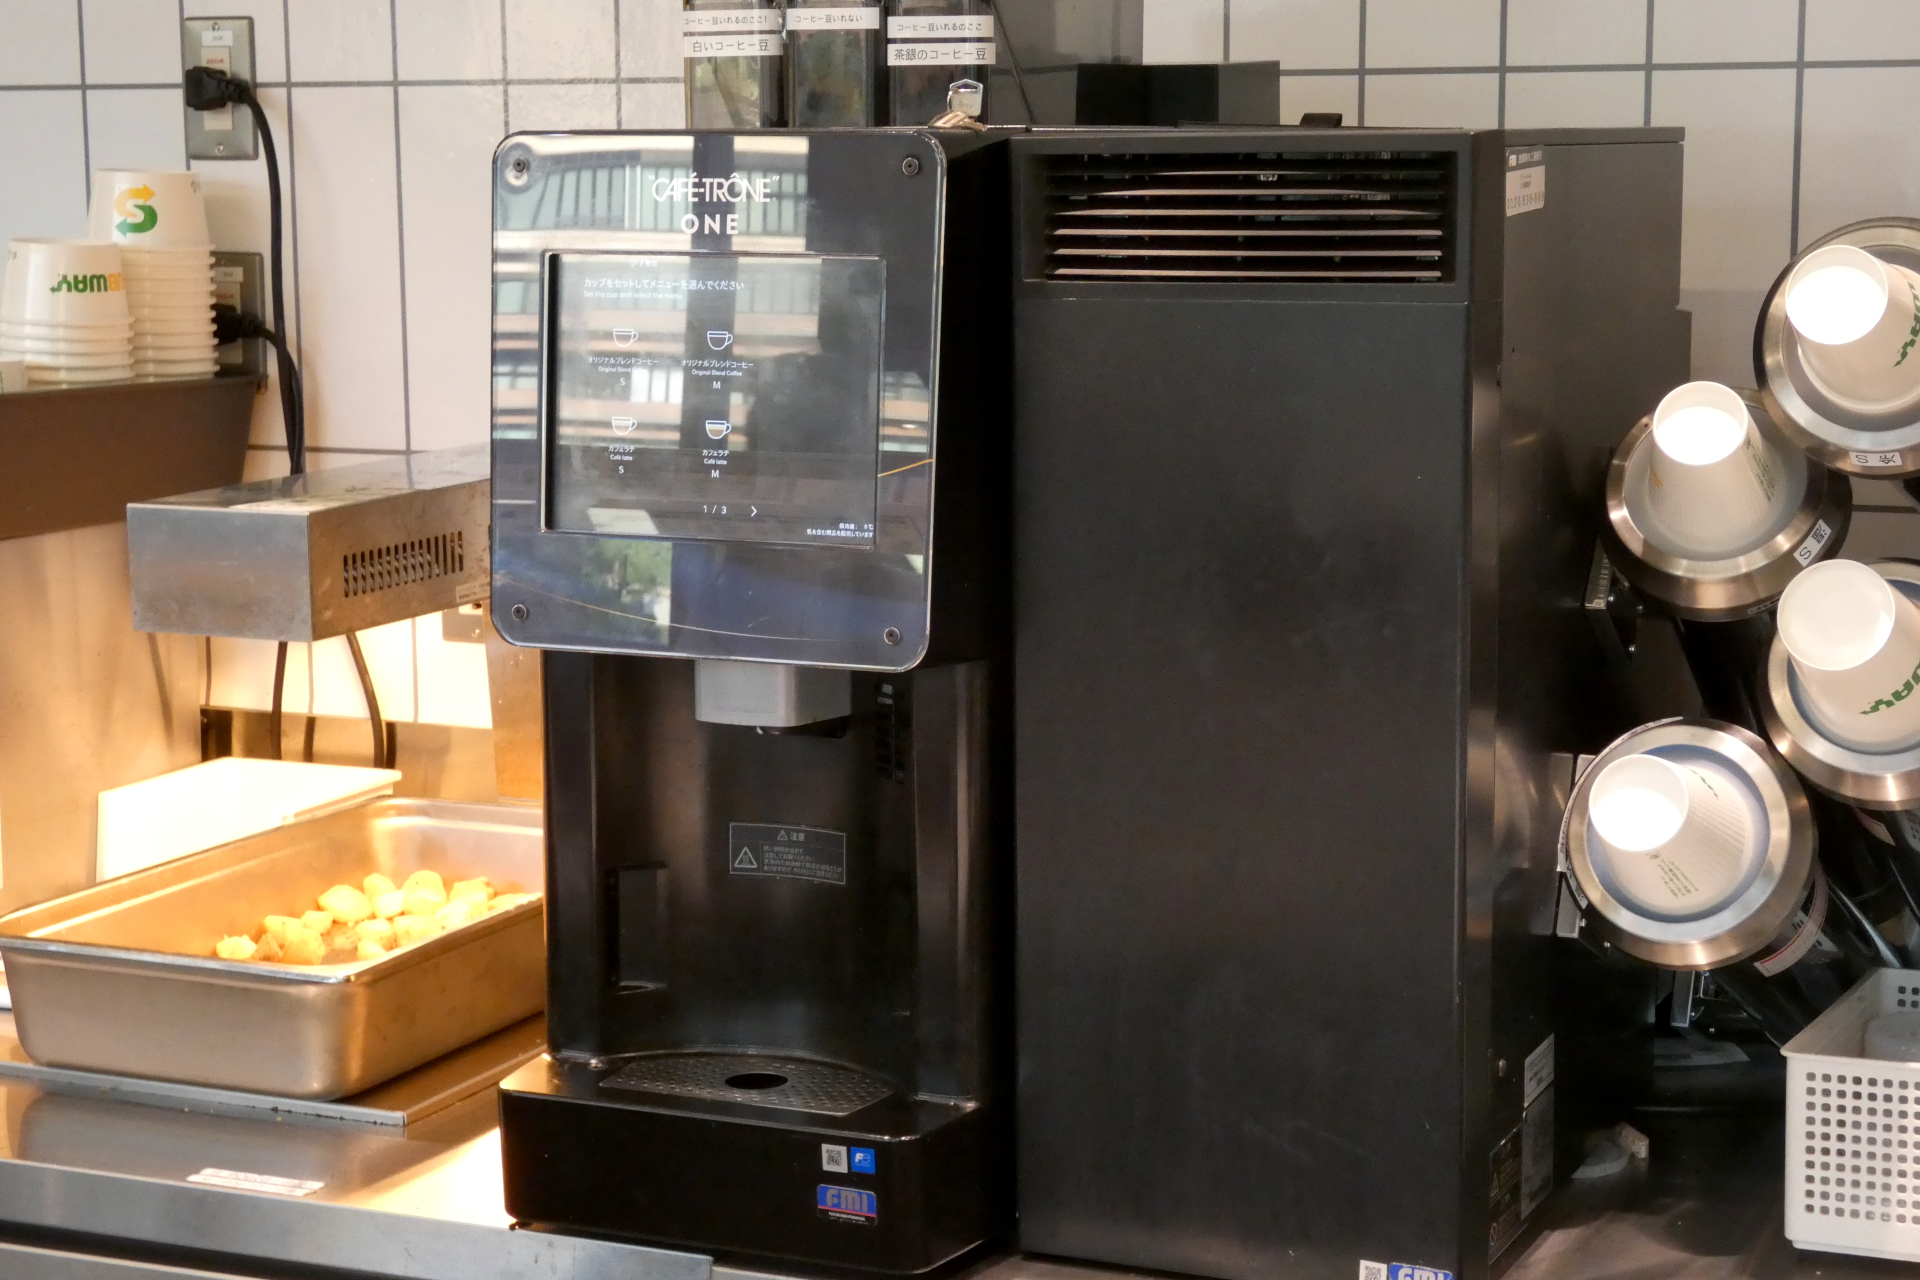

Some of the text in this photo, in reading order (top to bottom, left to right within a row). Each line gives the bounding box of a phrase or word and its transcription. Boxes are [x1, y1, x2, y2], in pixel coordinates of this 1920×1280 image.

[795, 13, 863, 23] コーヒー豆いれない
[897, 22, 982, 32] コーヒー豆いれるのここ
[692, 39, 770, 52] 白いコーヒー豆
[894, 47, 987, 61] 茶銀のコーヒー豆
[681, 213, 739, 235] ONE
[584, 277, 745, 291] カップをセットしてメニューを選んでください
[681, 359, 754, 369] オリジナルブレンドコーヒー
[620, 377, 626, 386] S
[712, 381, 721, 390] M
[608, 445, 636, 453] カフェラテ
[702, 449, 730, 457] カフェラテ
[618, 465, 625, 474] S
[711, 469, 720, 479] M
[790, 832, 805, 841] 注意
